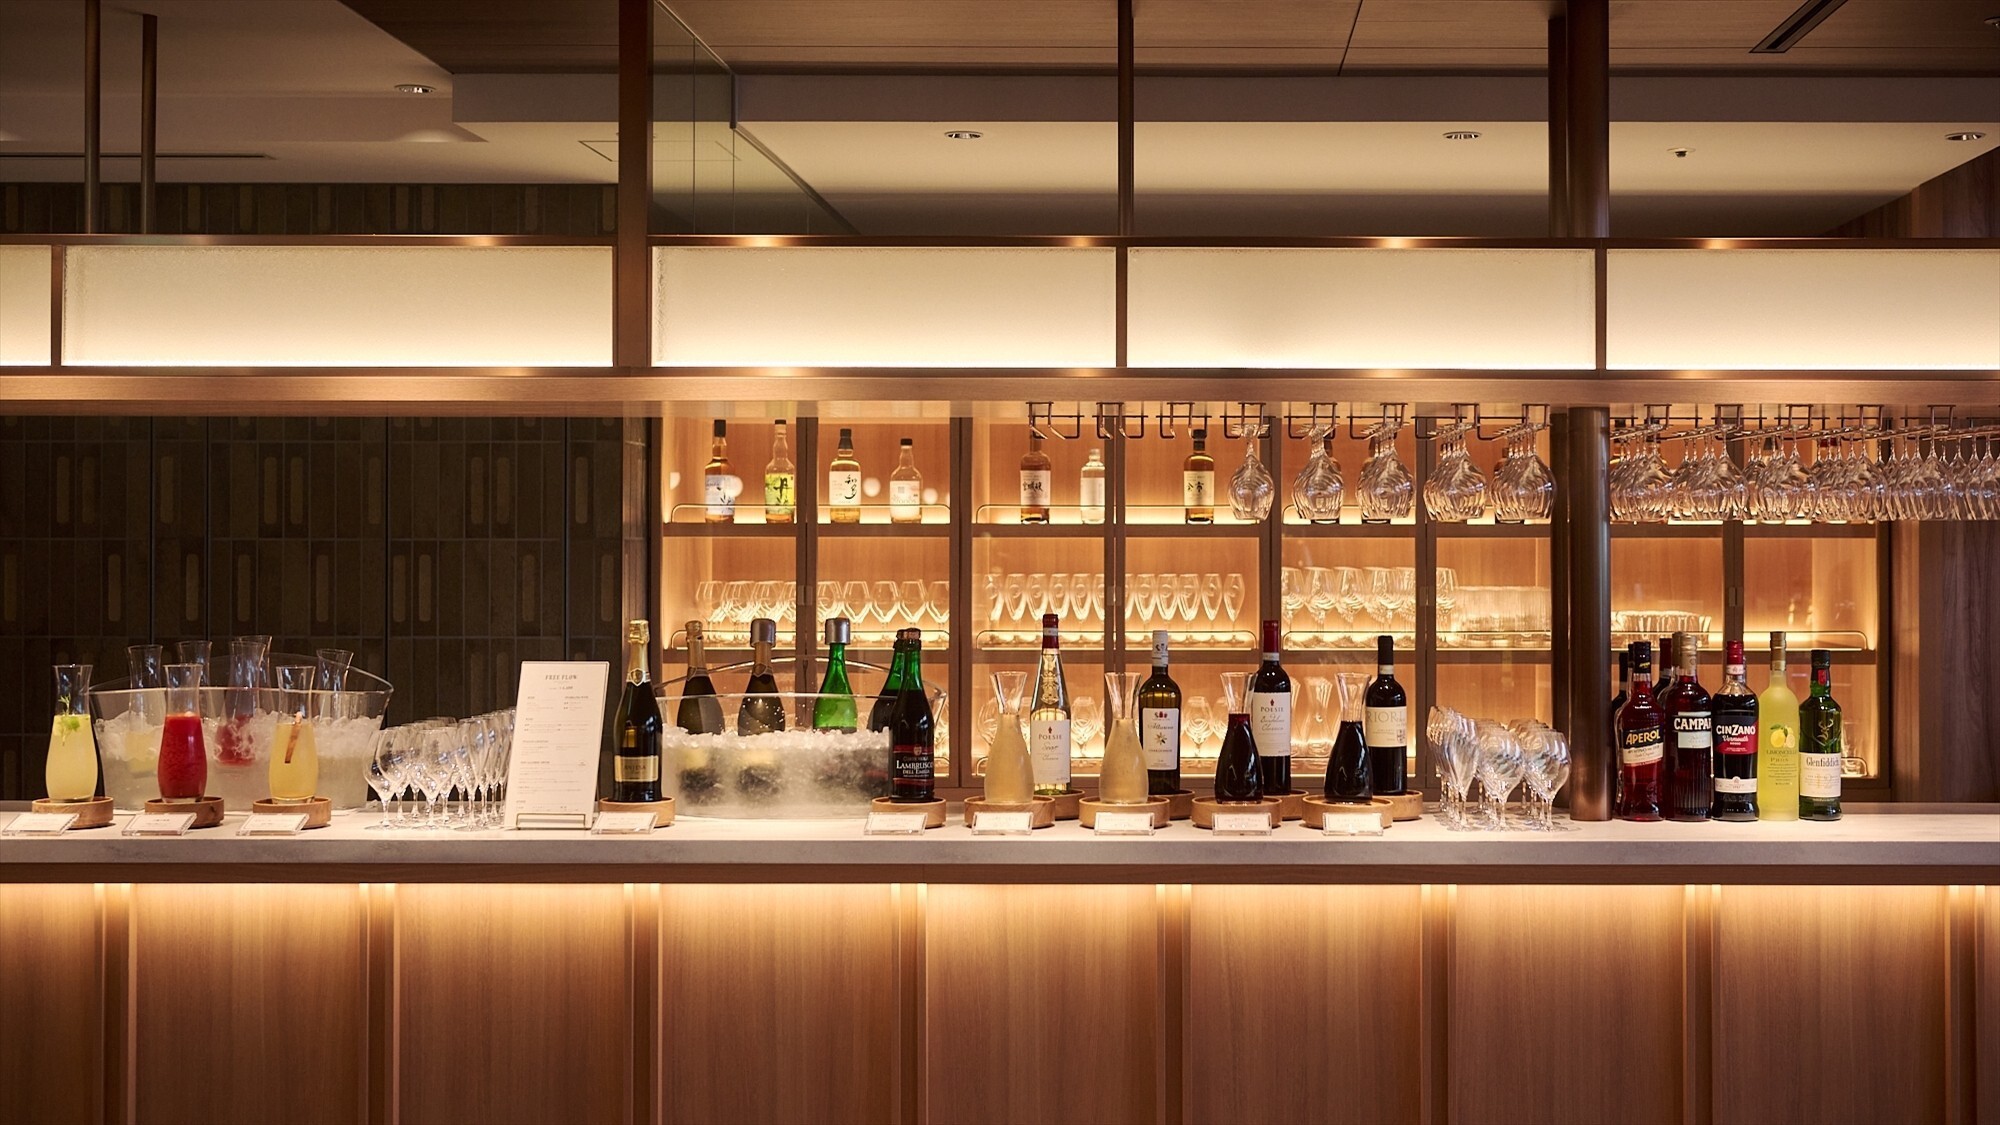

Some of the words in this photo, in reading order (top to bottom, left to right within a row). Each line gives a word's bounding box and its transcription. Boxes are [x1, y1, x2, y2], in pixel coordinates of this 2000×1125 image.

[1673, 718, 1711, 730] CAMPA
[1716, 724, 1756, 736] CINZANO
[1625, 729, 1661, 746] APEROL
